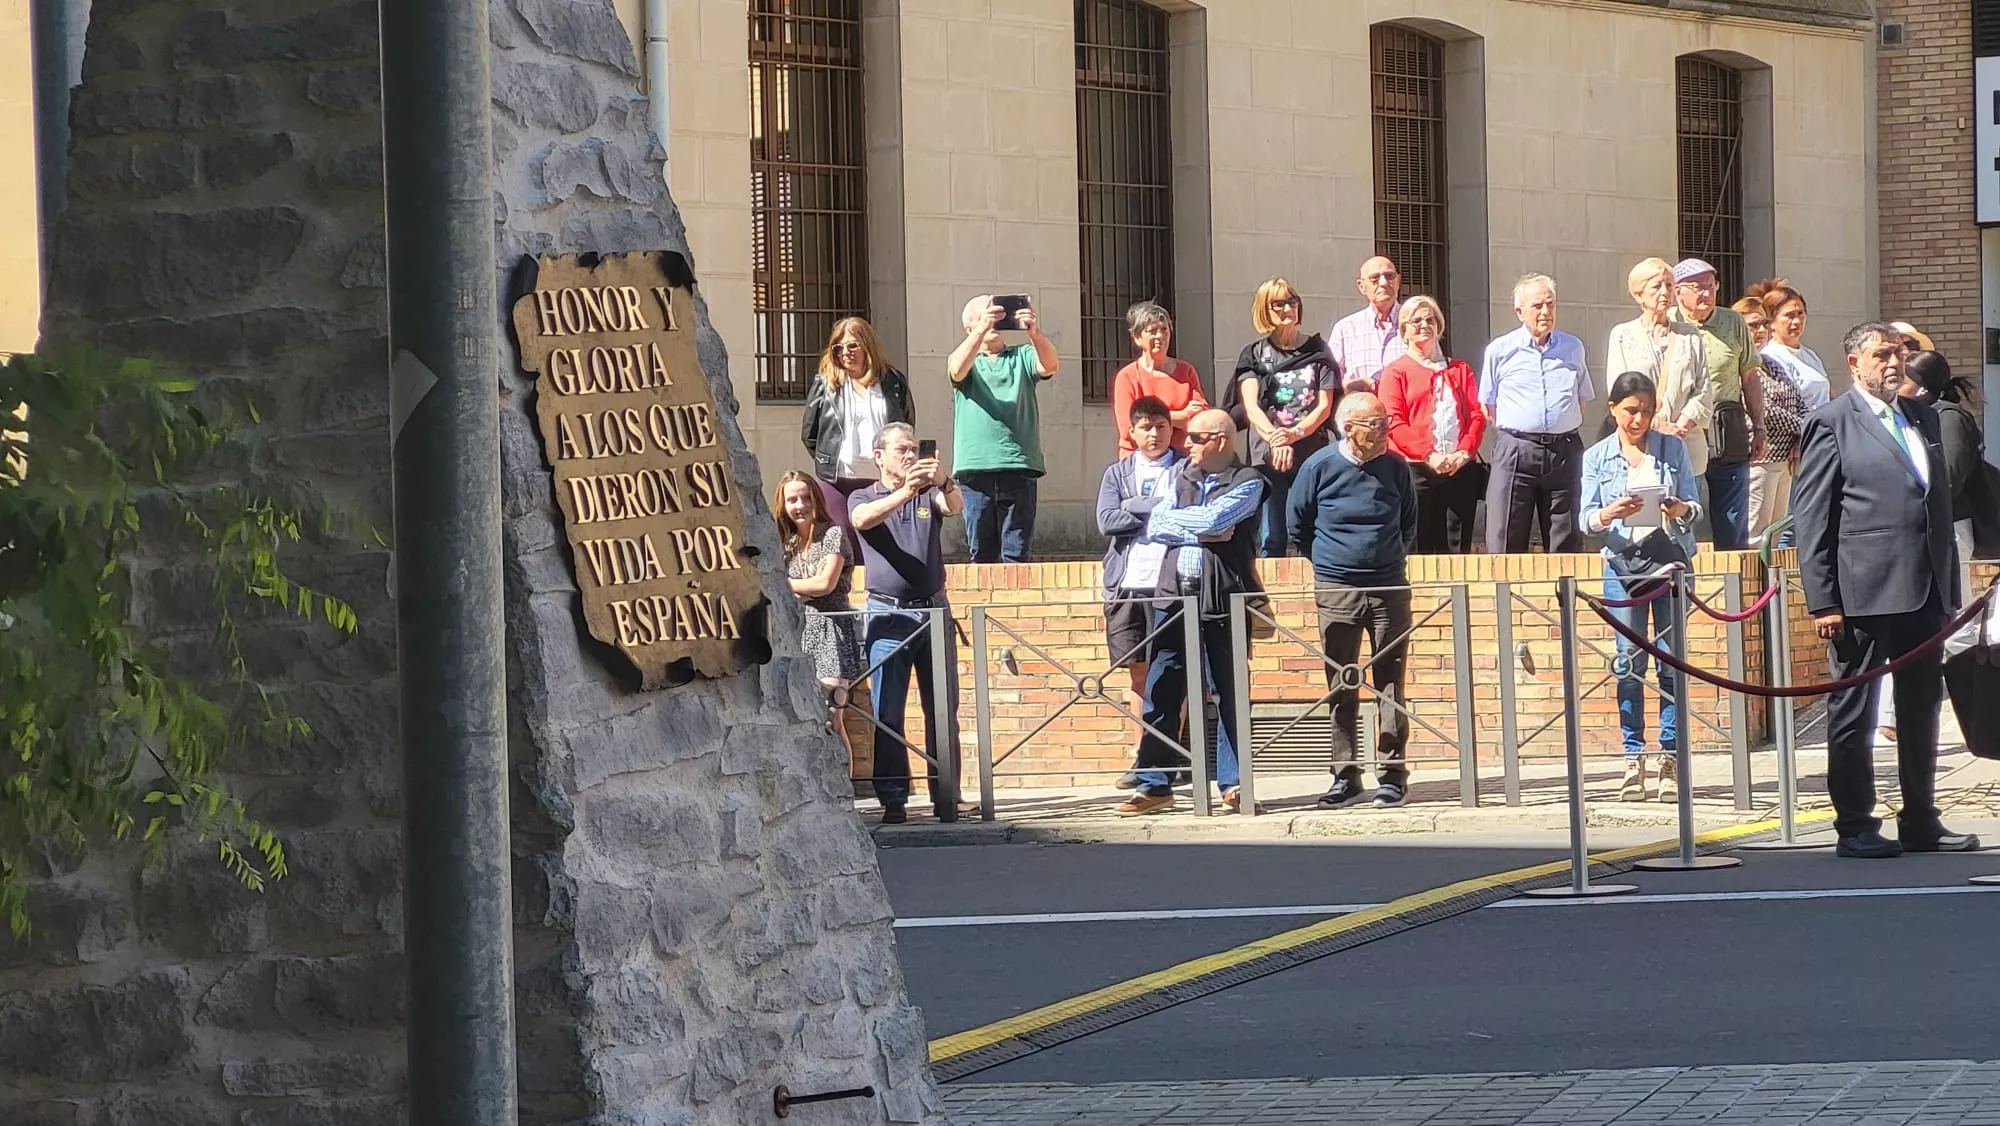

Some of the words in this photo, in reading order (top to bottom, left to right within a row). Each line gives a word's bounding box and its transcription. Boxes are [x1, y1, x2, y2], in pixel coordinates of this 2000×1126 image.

[537, 286, 649, 336] HONOR
[653, 286, 679, 331] Y
[549, 342, 674, 395] GLORIA
[557, 413, 582, 460] A
[581, 407, 646, 459] LOS
[647, 402, 718, 456] QUE
[566, 467, 684, 524] DIERON
[690, 461, 730, 508] SU
[582, 533, 666, 587] VIDA
[671, 525, 741, 575] POR
[609, 580, 741, 647] ESPAÑA
